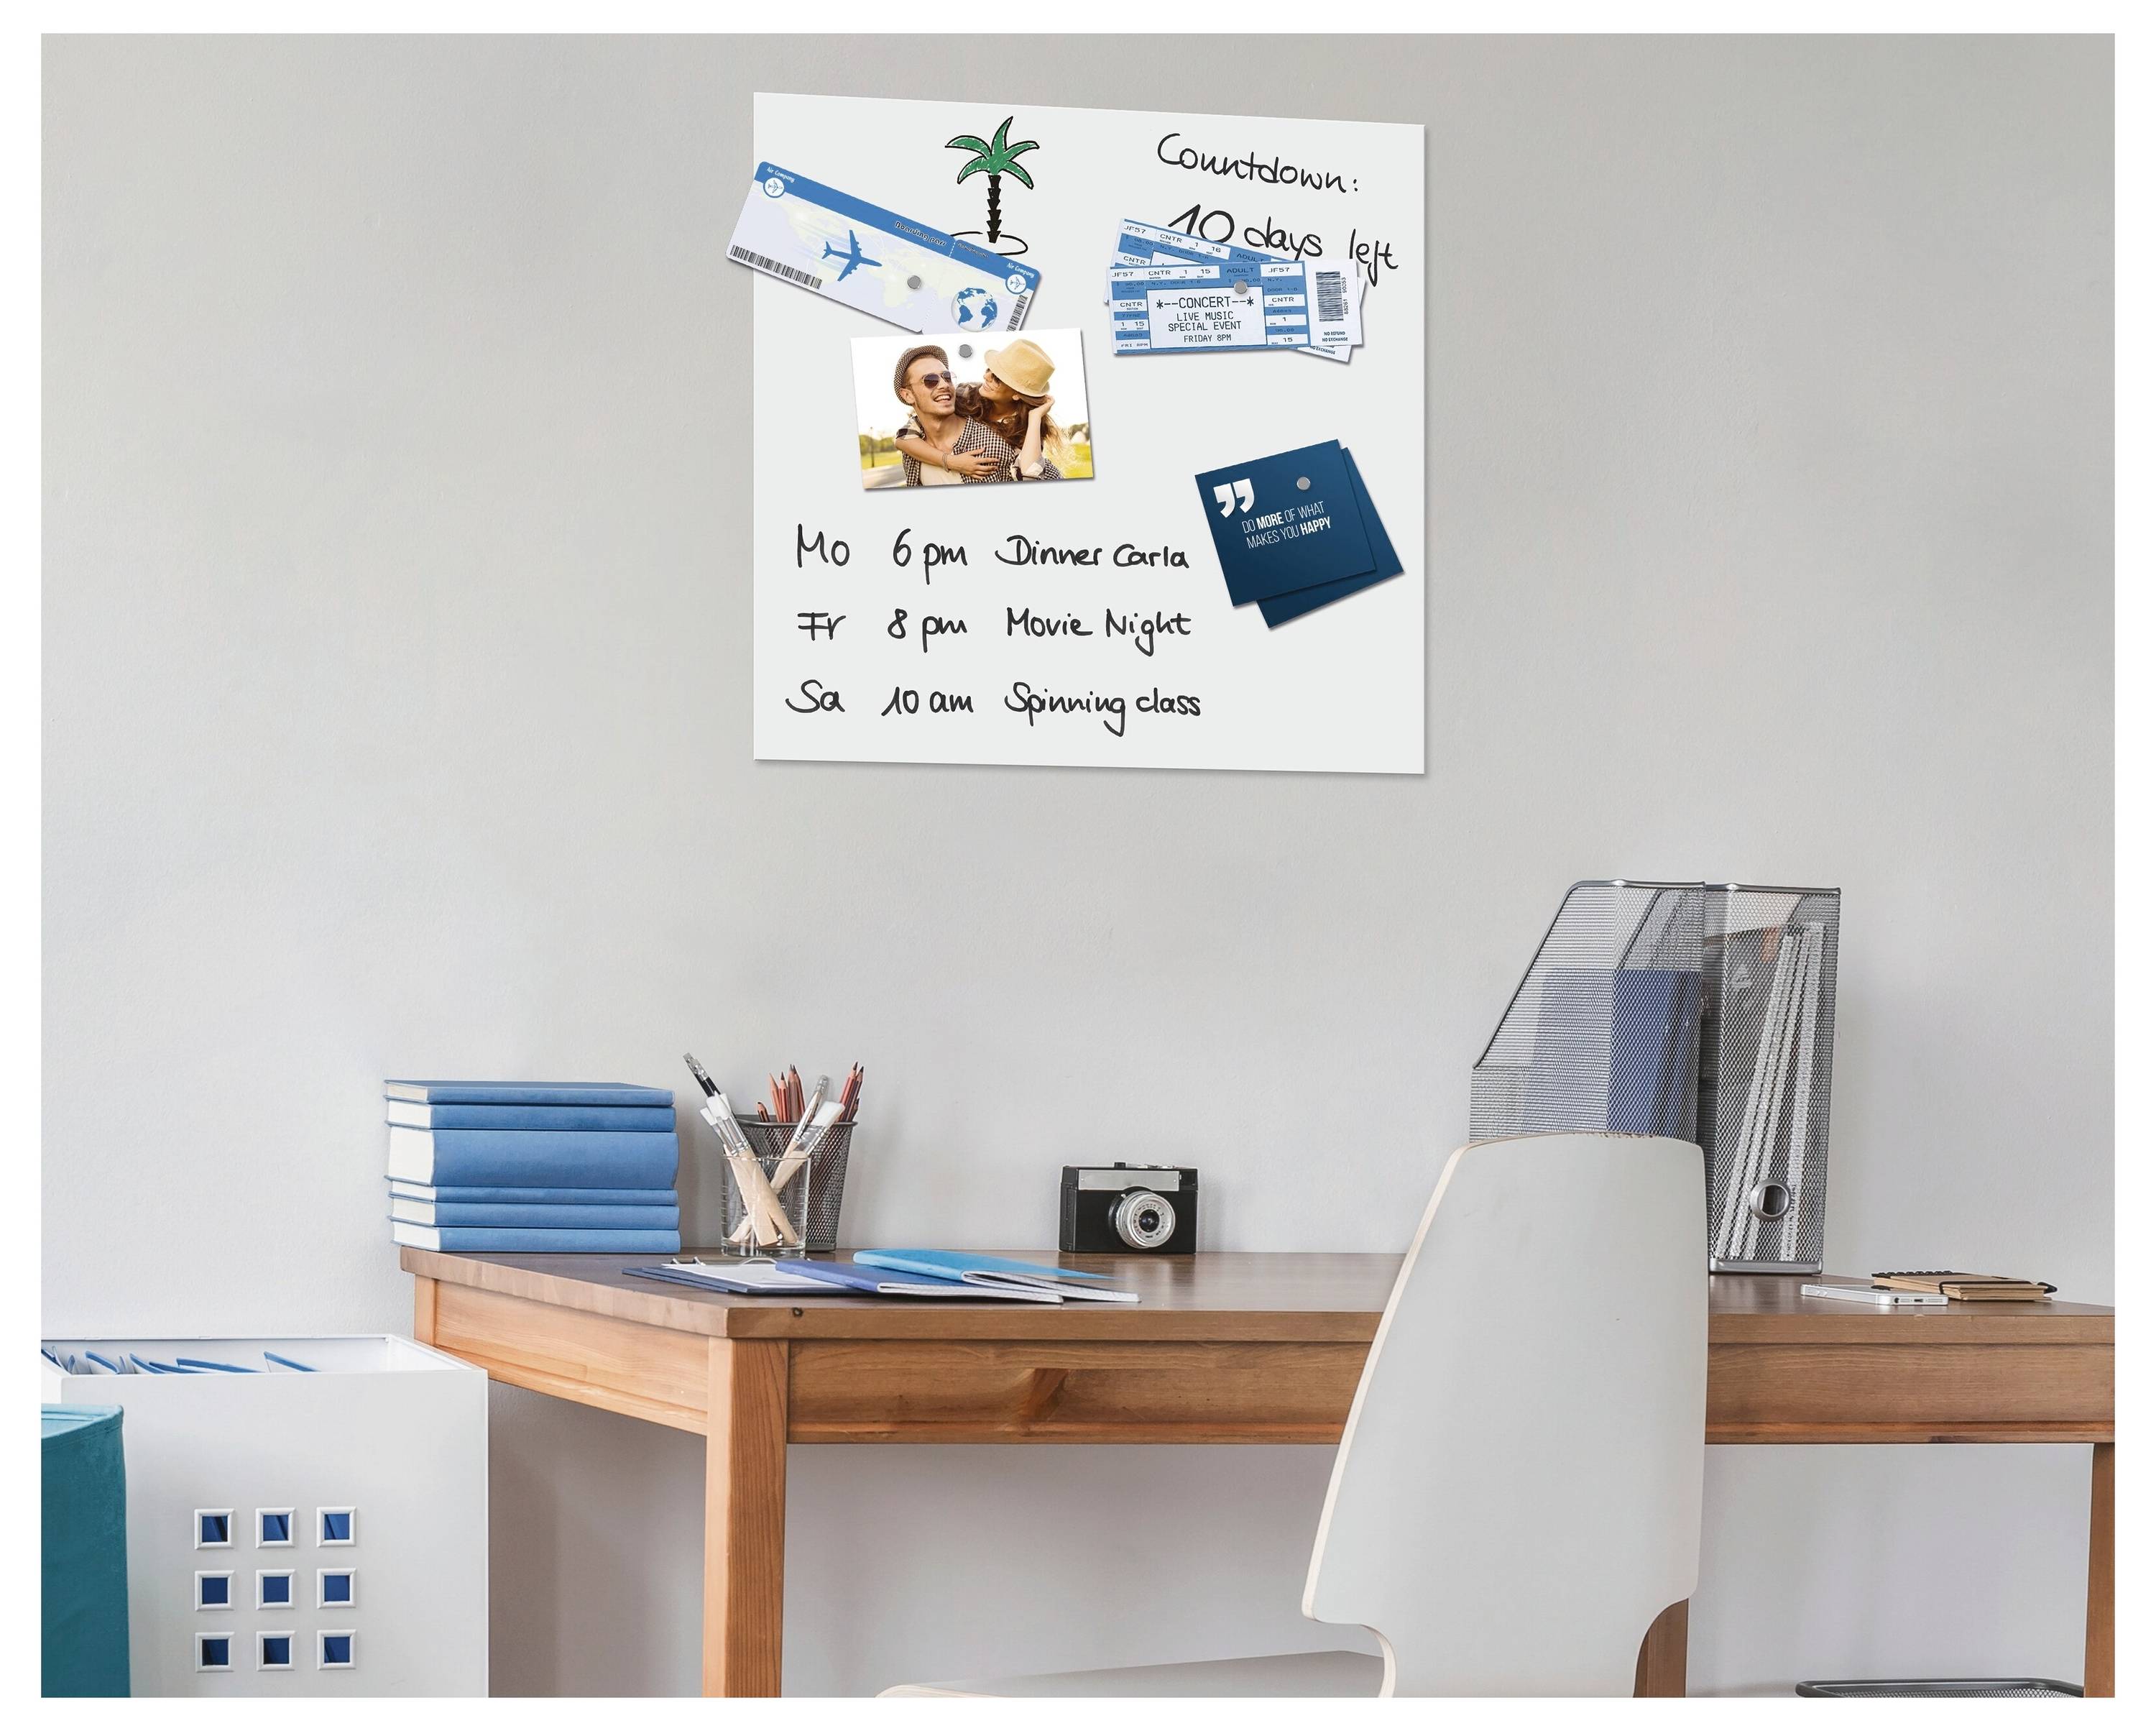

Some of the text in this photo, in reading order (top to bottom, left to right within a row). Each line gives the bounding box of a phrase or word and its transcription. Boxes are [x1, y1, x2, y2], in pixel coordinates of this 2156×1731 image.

[1157, 133, 1358, 193] Countdown:
[775, 170, 795, 183] Company
[895, 221, 929, 241] Boarding
[1124, 225, 1146, 234] JF57
[1160, 234, 1182, 243] CNTR
[1168, 204, 1399, 287] 10 days left
[1123, 255, 1146, 265] CNTR
[1015, 265, 1035, 279] Company
[1177, 311, 1234, 322] LIVE MUSIC
[1168, 321, 1242, 332] SPECIAL EVENT
[1184, 334, 1212, 343] FRIDAY
[1242, 501, 1325, 533] DO MORE OF WHAT
[1246, 516, 1332, 548] MAKES YOU HAPPY
[797, 523, 1190, 586] Mo 6 pm Dinner Carla
[797, 607, 1192, 657] Fr 8 pm Movie Night
[785, 679, 1201, 738] Sa 10 am Spinning class
